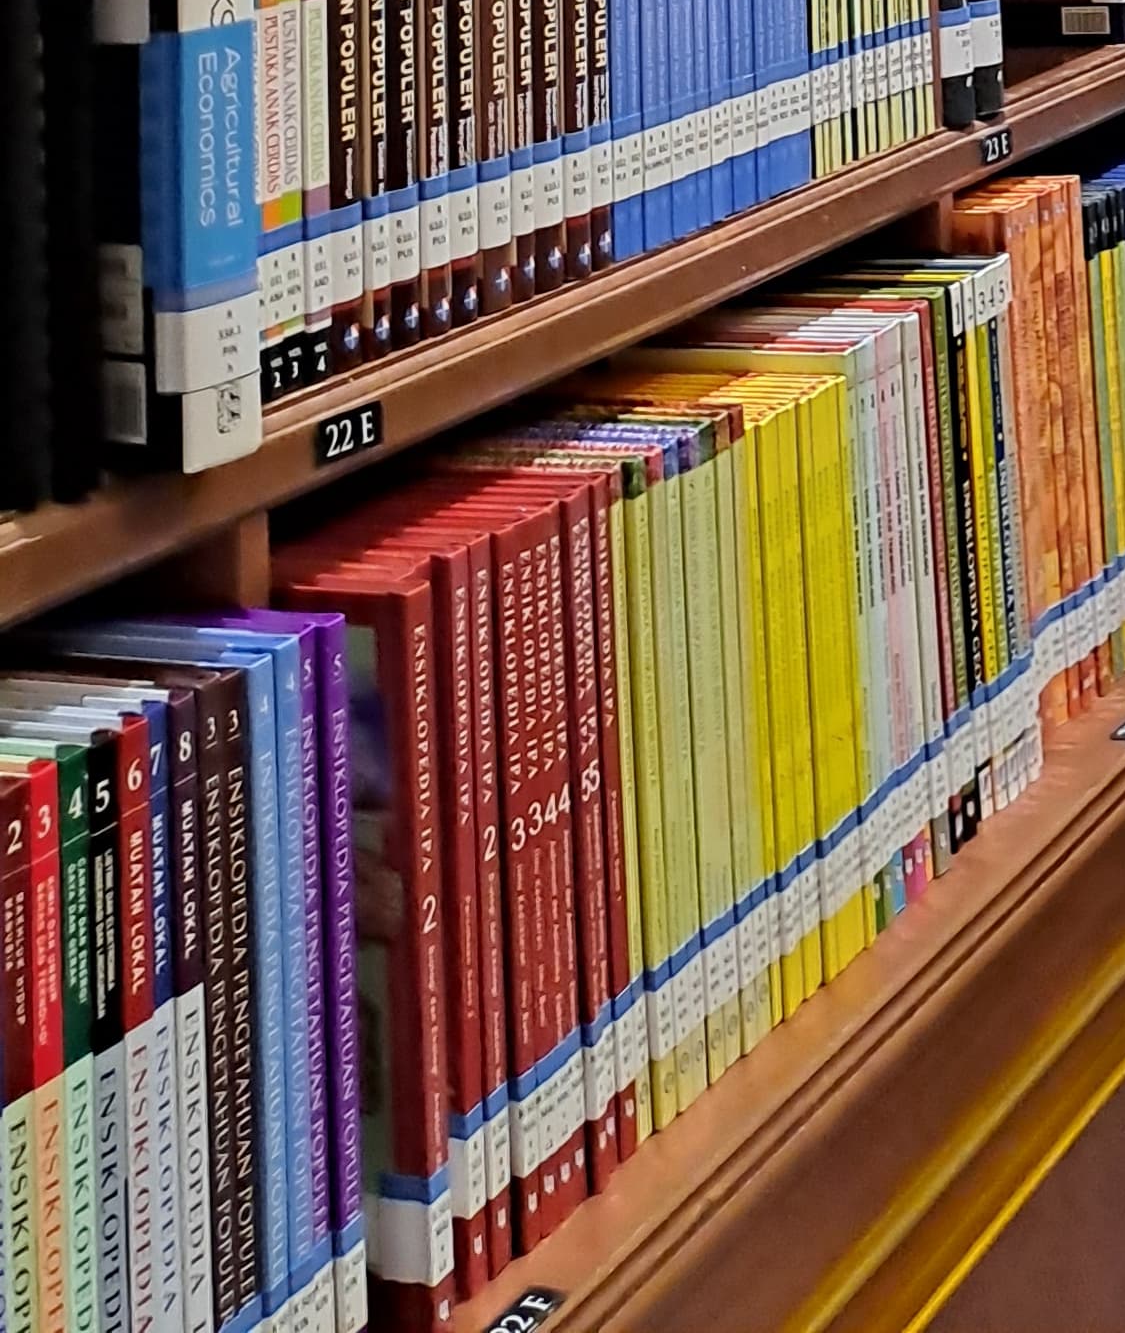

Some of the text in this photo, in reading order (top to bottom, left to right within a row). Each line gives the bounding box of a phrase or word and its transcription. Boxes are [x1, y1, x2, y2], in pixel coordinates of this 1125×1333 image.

[400, 2, 416, 123] POPULER
[340, 25, 355, 141] POPULER
[264, 15, 281, 194] PUSTAKA ANAK CERDAS
[197, 50, 219, 226] Economics
[221, 46, 243, 225] Agricultural
[985, 135, 1000, 164] 23
[326, 411, 375, 457] 22 E
[503, 562, 520, 745] ENSIKLOPEDIA
[414, 623, 431, 820] ENSIKLOPEDIA
[151, 743, 163, 776] 7
[179, 731, 191, 762] 8
[127, 758, 142, 791] 6
[68, 786, 81, 820] 4
[95, 779, 110, 813] 5
[544, 793, 558, 824] 4
[557, 781, 571, 813] 4
[38, 804, 51, 838] 3
[511, 816, 525, 851] 3
[529, 801, 542, 835] 3
[6, 820, 23, 856] 2
[484, 825, 496, 861] 2
[180, 799, 196, 959] MUATAN LOKAL
[129, 830, 146, 996] MUATAN LOKAL
[332, 708, 354, 1102] ENSIKLOPEDIA PENGETAHUAN
[423, 895, 437, 934] 2
[227, 767, 253, 1180] ENSIKLOPEDIA PENGETAHUAN
[155, 1025, 175, 1312] ENSIKLOPEDIA
[184, 1008, 207, 1294] ENSIKLOPEDIA
[520, 1295, 553, 1311] F
